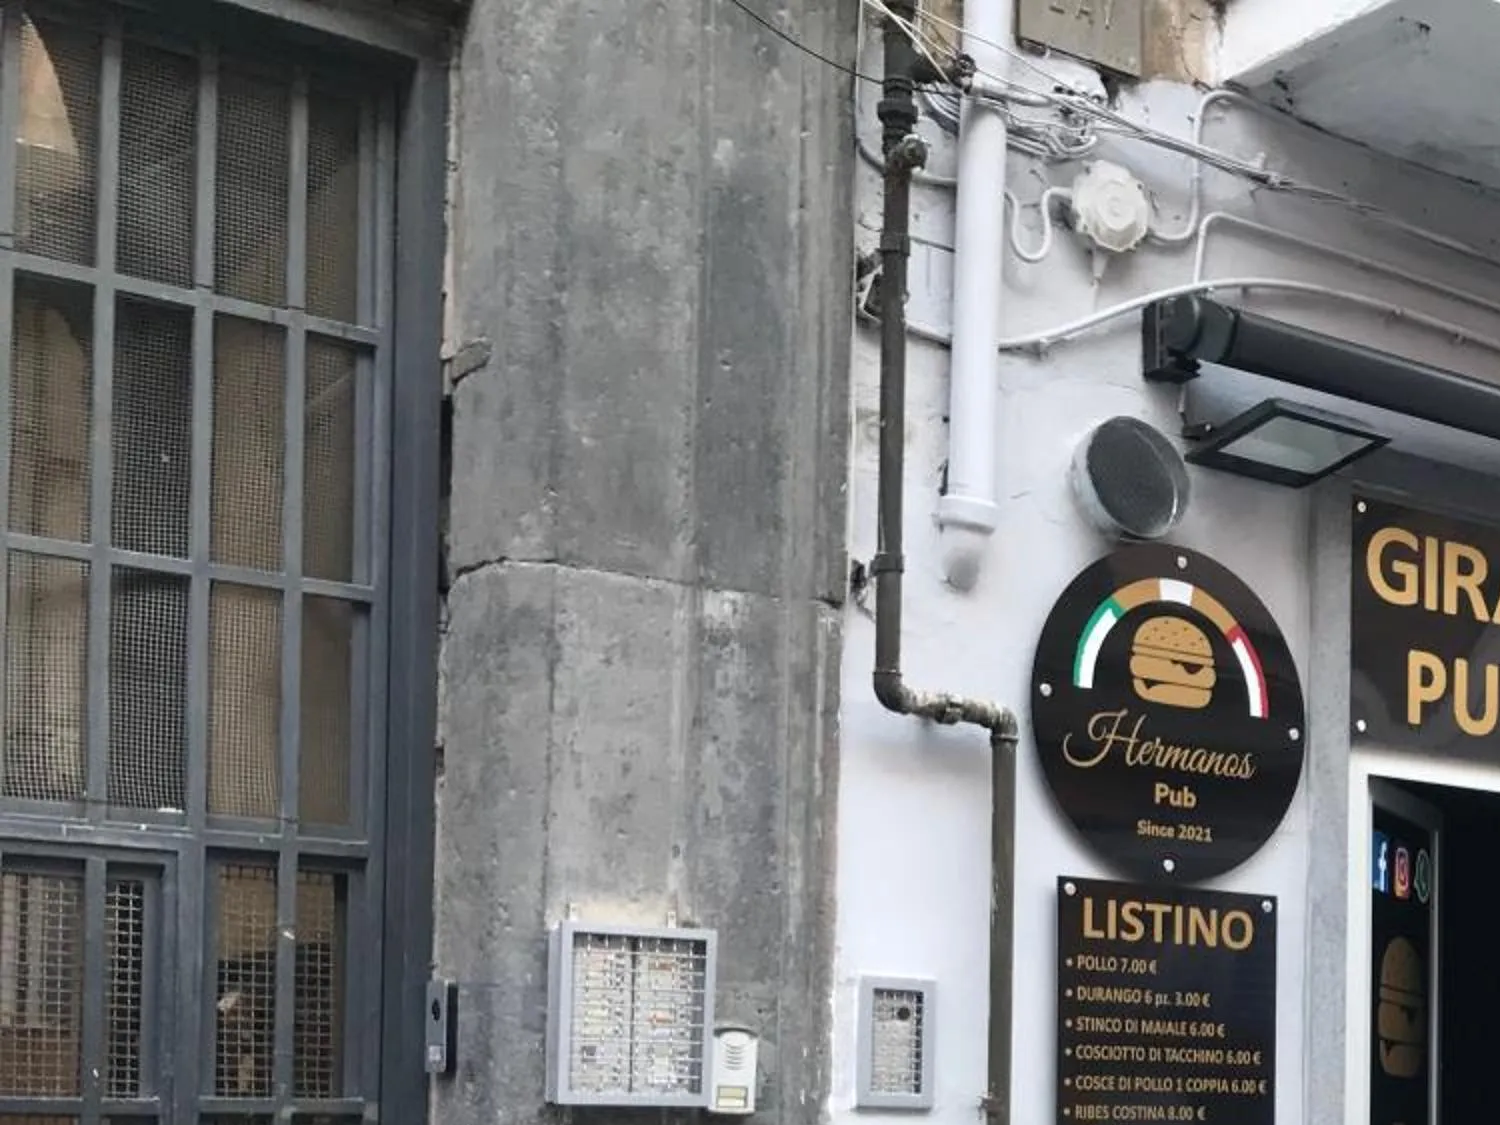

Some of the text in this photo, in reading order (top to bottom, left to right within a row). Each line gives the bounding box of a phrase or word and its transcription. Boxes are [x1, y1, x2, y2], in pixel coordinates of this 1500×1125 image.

[1063, 709, 1256, 779] Hermanos
[1155, 783, 1197, 809] Pub
[1137, 819, 1212, 842] Since 2021
[1083, 897, 1254, 950] LISTINO
[1077, 955, 1117, 972] POLLO
[1121, 957, 1147, 974] 7.00
[1077, 986, 1141, 1003] DURANGO
[1076, 1017, 1225, 1038] STINCO DI MAIALE 6.00 €
[1076, 1045, 1145, 1062] COSCIOTTO
[1150, 1048, 1161, 1062] DI
[1164, 1049, 1223, 1064] TACCHINO
[1252, 1051, 1261, 1065] €
[1075, 1075, 1115, 1090] COSCE
[1119, 1076, 1131, 1091] DI
[1135, 1078, 1172, 1092] POLLO
[1186, 1078, 1229, 1093] COPPIA
[1231, 1080, 1255, 1094] 6.00
[1258, 1080, 1267, 1094] €
[1075, 1105, 1109, 1120] RIBES
[1112, 1106, 1165, 1121] COSTINA
[1197, 1107, 1206, 1121] €
